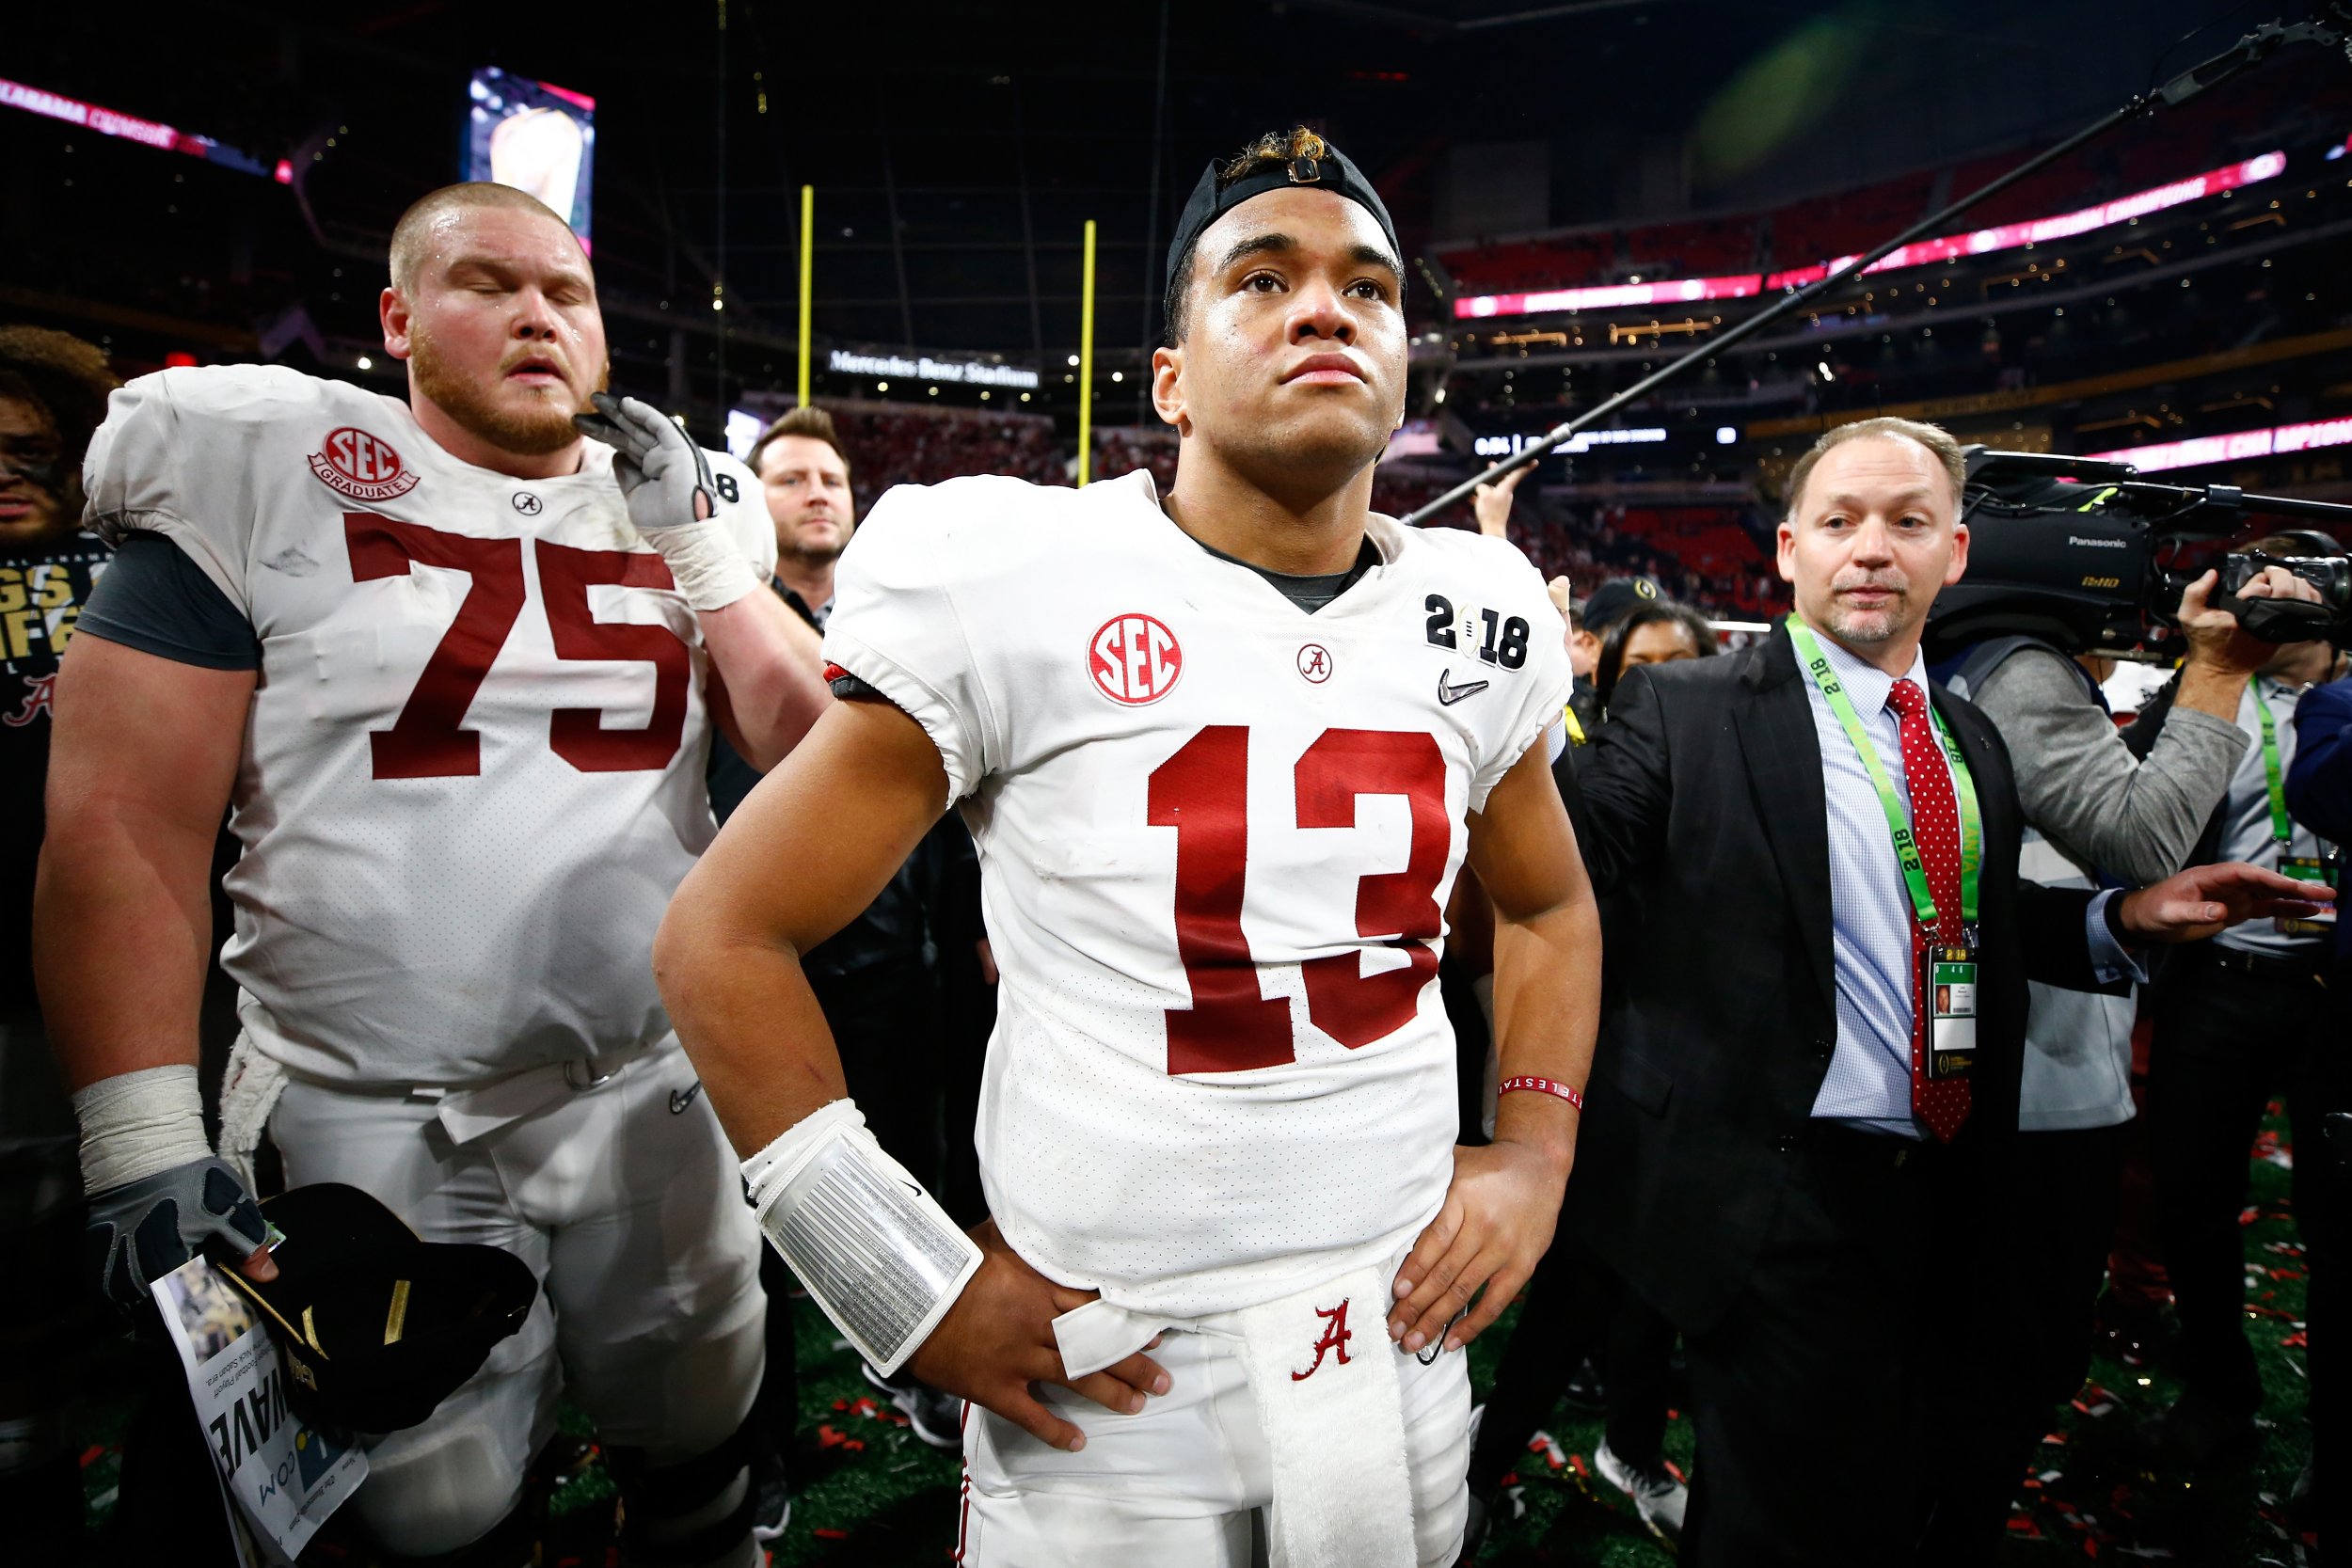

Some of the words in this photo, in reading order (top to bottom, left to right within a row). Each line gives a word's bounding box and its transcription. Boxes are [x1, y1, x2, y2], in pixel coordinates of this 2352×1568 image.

[0, 81, 87, 124] LABAMA
[331, 431, 394, 481] SEC
[321, 468, 405, 498] GRADUATE
[715, 473, 739, 503] 8
[2069, 535, 2126, 548] Panasonic
[0, 563, 74, 613] GS
[342, 512, 691, 780] 75
[1094, 618, 1175, 701] SEC
[1147, 724, 1451, 1076] 13
[217, 1357, 239, 1378] Saban
[238, 1348, 253, 1363] Nick
[204, 1372, 220, 1387] era.
[214, 1374, 235, 1400] Playoff
